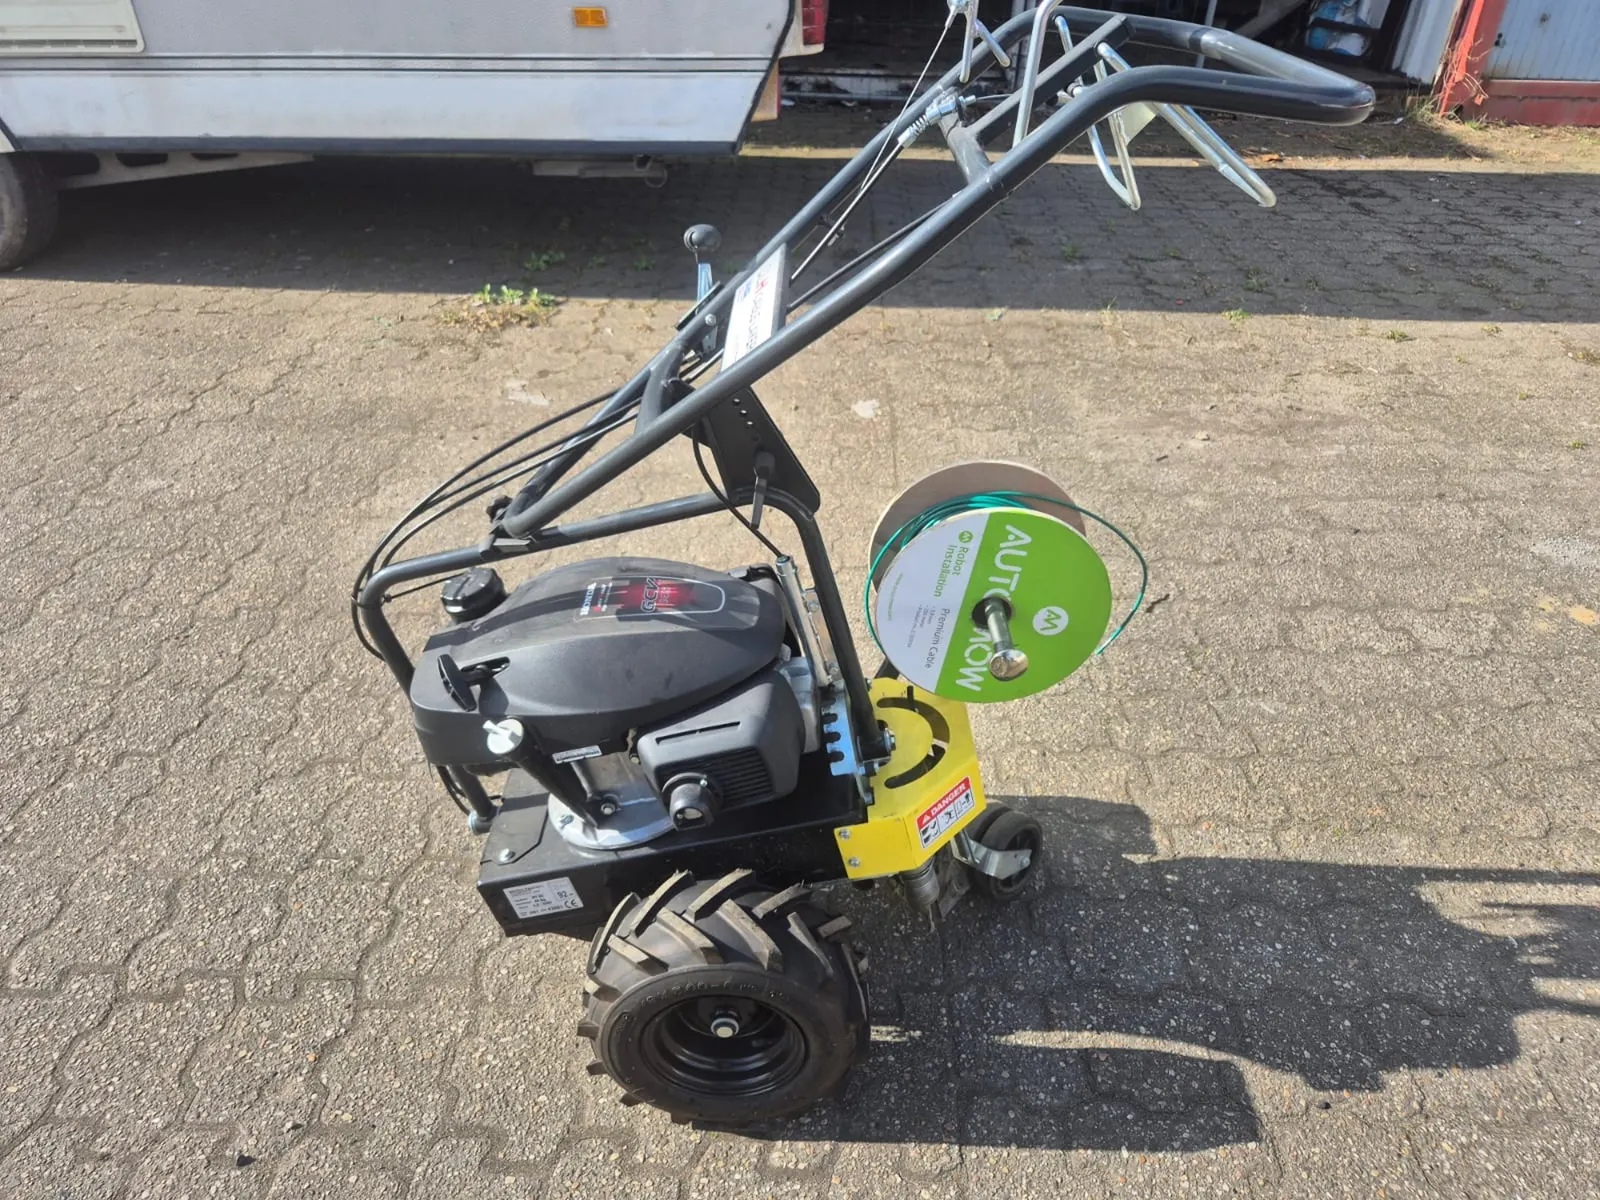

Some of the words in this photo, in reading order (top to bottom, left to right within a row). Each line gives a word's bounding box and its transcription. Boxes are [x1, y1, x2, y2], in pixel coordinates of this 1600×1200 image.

[934, 544, 957, 597] Installation
[952, 546, 969, 576] Robot
[580, 582, 597, 616] HONDA
[641, 577, 659, 612] GCV
[932, 608, 951, 645] Premium
[925, 646, 939, 669] Cable
[931, 783, 966, 816] DANGER
